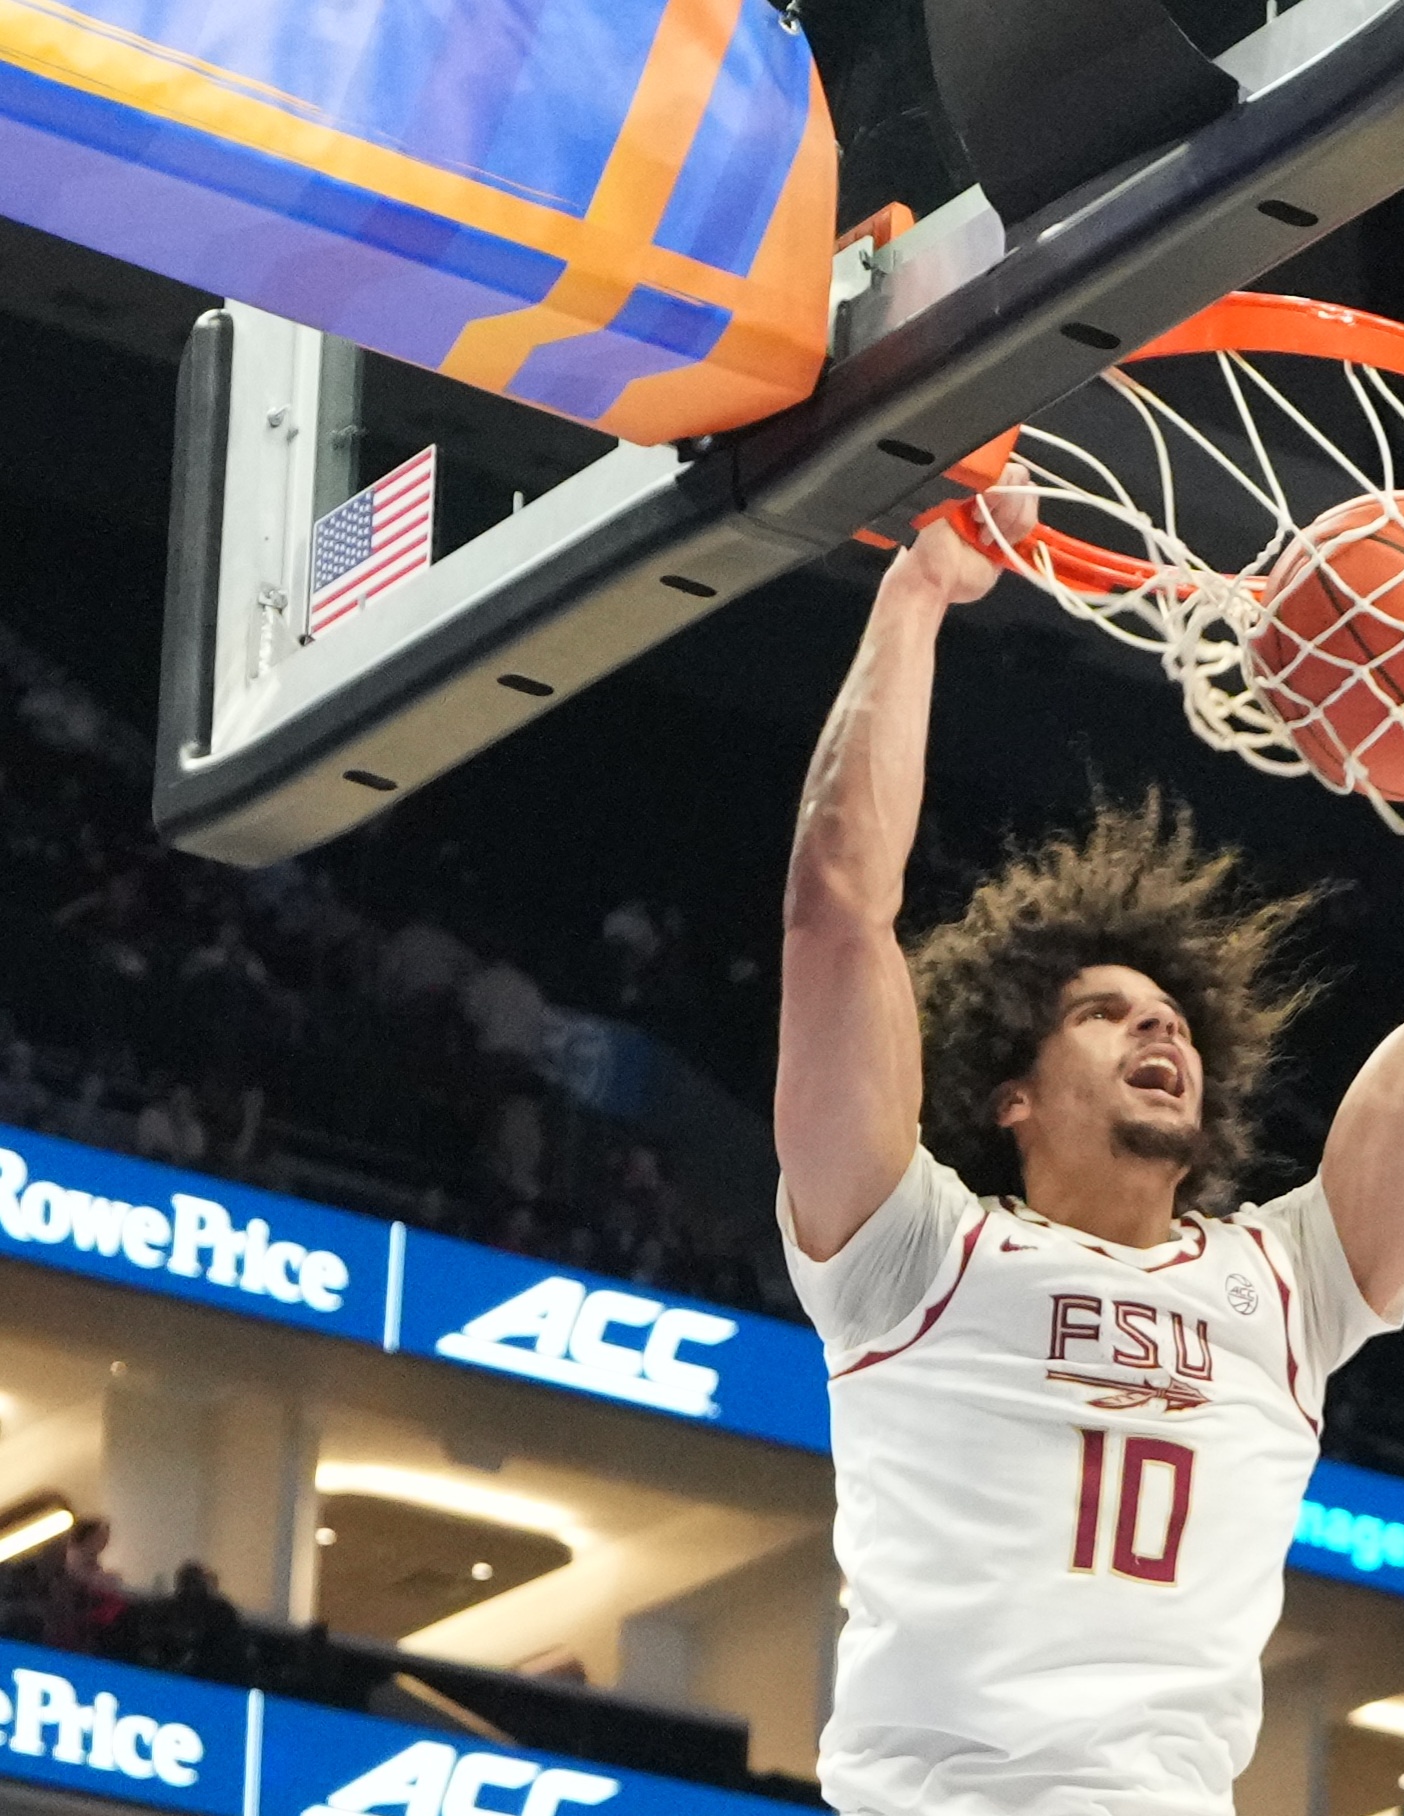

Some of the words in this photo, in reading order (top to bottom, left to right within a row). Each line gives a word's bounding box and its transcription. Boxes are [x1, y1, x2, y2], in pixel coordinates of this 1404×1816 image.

[455, 1277, 738, 1400] ACC
[1046, 1294, 1214, 1381] FSU
[1067, 1427, 1197, 1588] 10
[0, 1667, 204, 1787] Price
